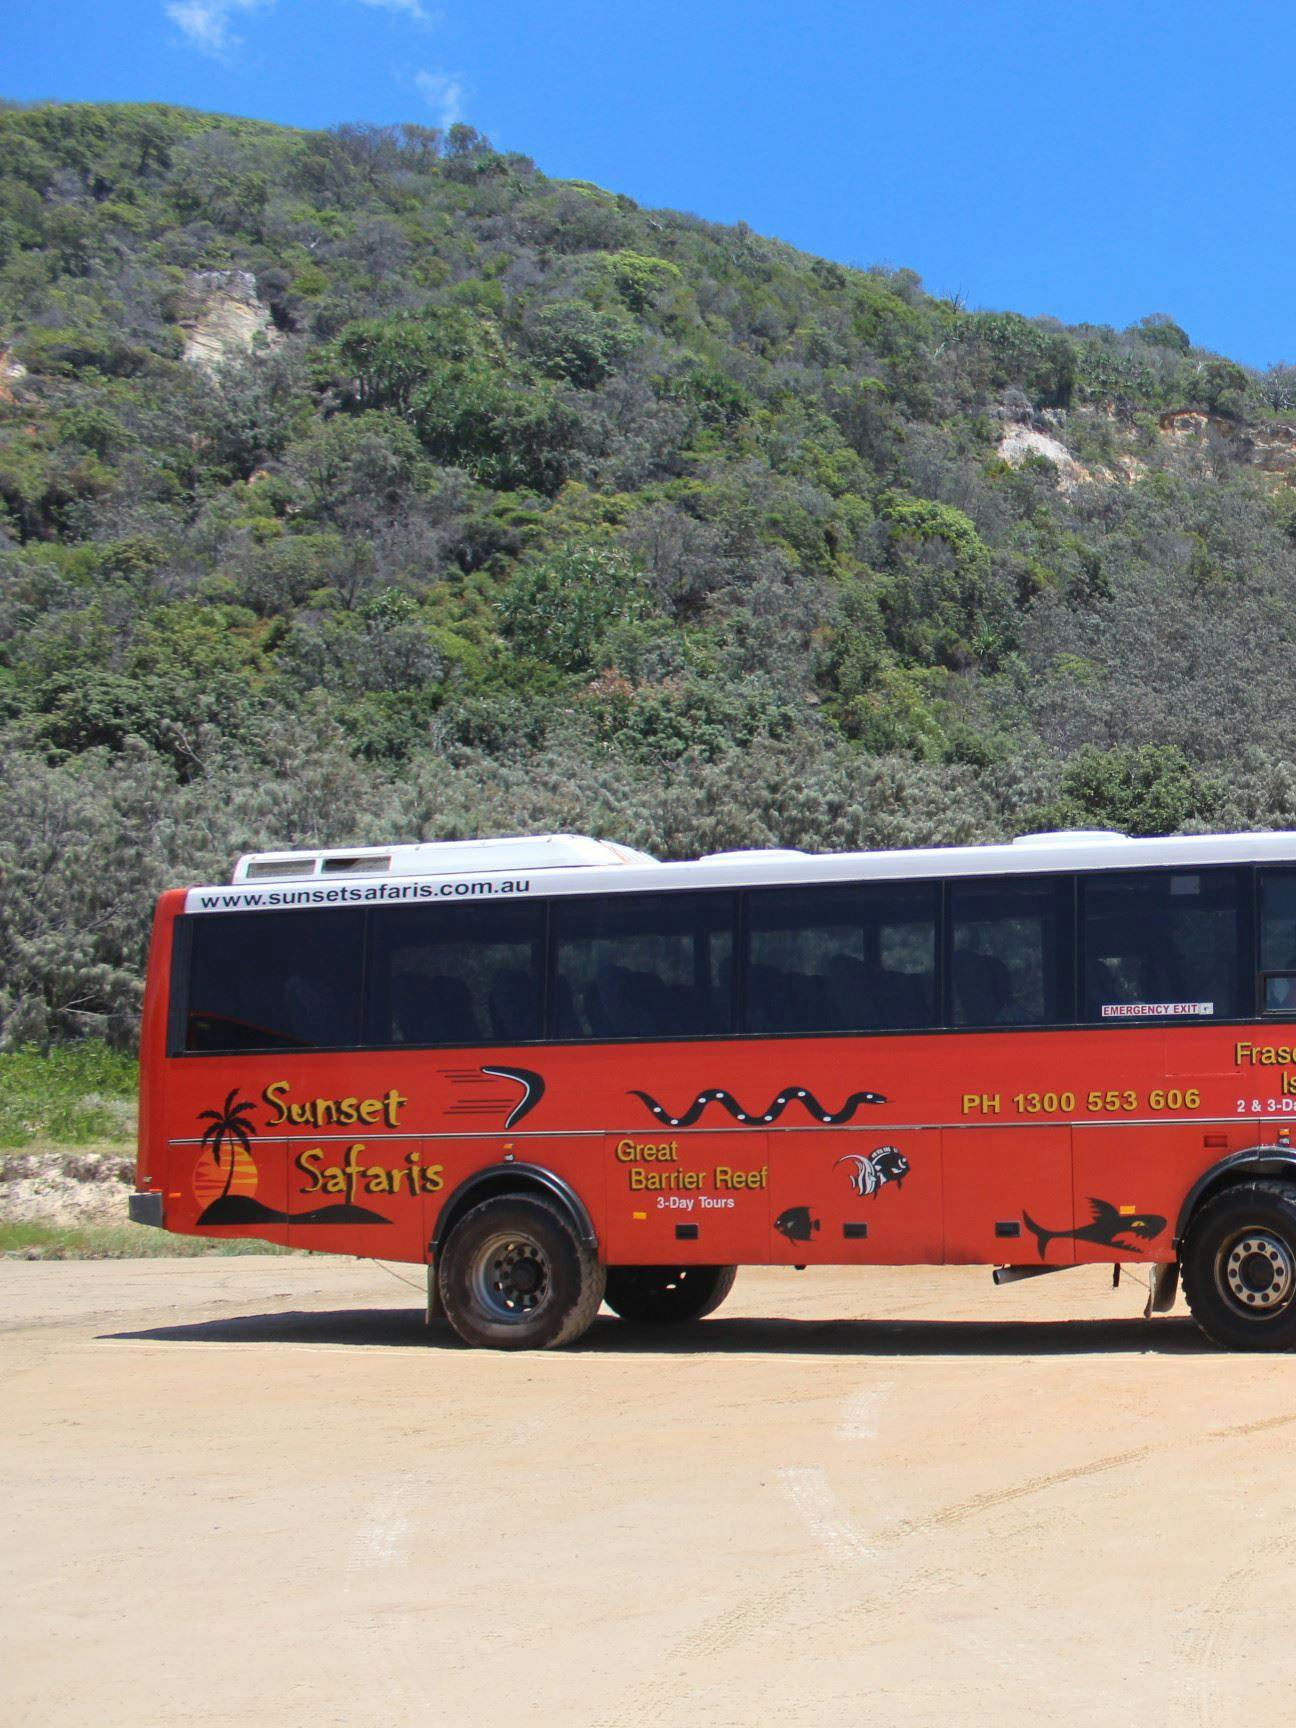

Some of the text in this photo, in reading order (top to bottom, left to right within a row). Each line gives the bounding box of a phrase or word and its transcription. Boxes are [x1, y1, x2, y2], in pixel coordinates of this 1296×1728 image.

[201, 880, 530, 909] www.sunsetsafaris.com.au
[1103, 1003, 1198, 1016] EMERGENCY EXIT
[264, 1081, 407, 1128] Sunset
[962, 1089, 1201, 1115] PH 1300 553 606
[1237, 1100, 1246, 1112] 2
[1251, 1099, 1262, 1112] &
[616, 1139, 678, 1162] Great
[297, 1144, 444, 1205] Safaris
[630, 1166, 768, 1191] Barrier Reef
[656, 1196, 734, 1211] 3-Day Tours
